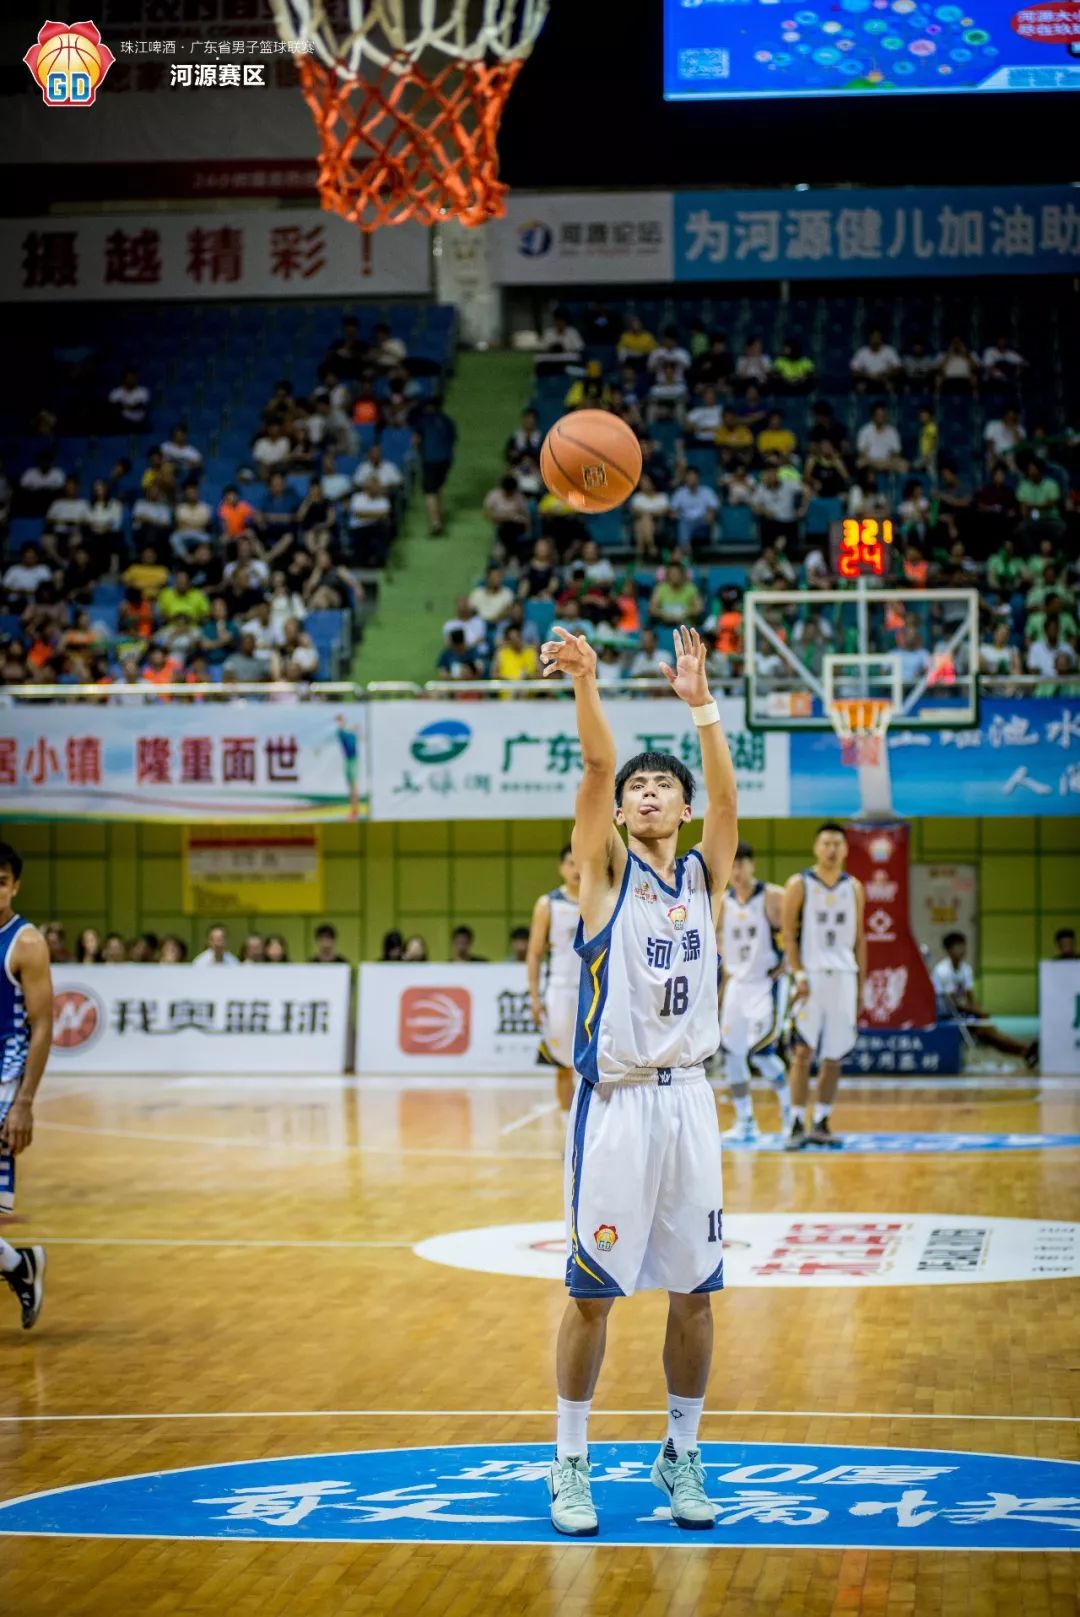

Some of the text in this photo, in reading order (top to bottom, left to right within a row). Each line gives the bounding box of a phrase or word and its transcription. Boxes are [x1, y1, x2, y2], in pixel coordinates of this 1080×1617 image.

[684, 203, 1080, 263] 为河源健儿加油助
[136, 736, 299, 785] 隆重面世
[502, 732, 583, 775] 广东
[646, 928, 701, 970] 河源
[660, 975, 689, 1017] 18
